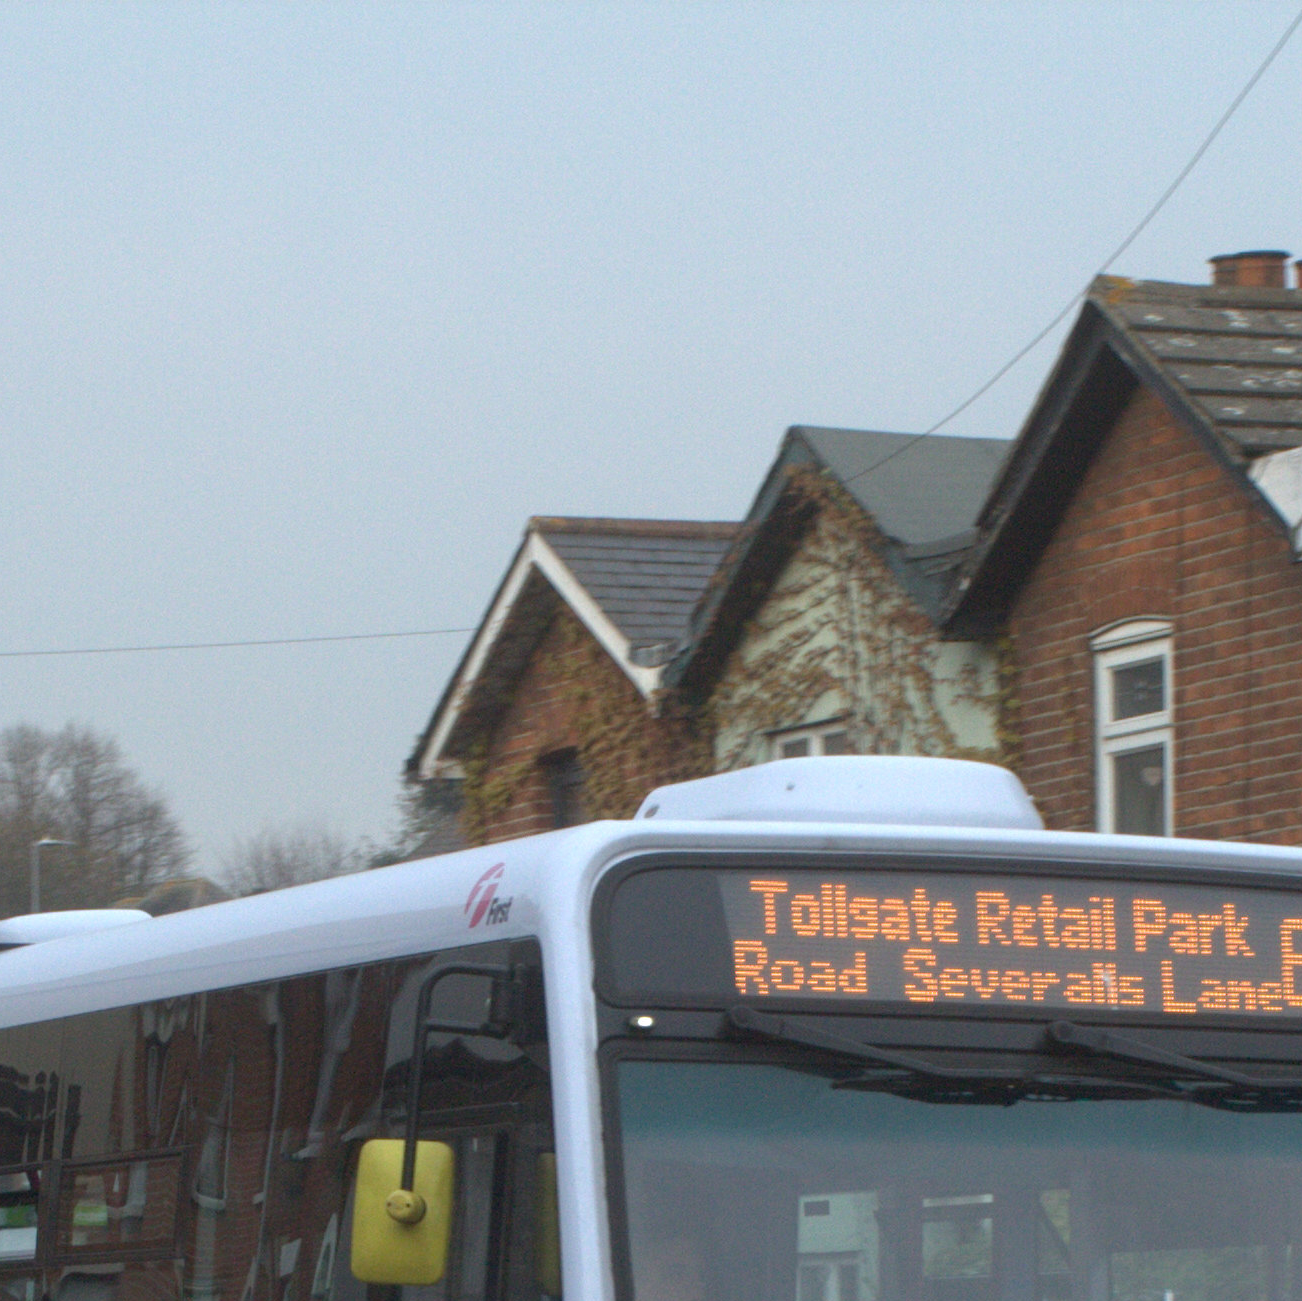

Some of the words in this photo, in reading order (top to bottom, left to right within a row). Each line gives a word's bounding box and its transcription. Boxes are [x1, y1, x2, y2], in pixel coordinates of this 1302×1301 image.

[749, 879, 959, 943] Tollgate
[975, 890, 1118, 951] Retail
[1132, 898, 1256, 957] Park
[734, 940, 869, 996] Road
[902, 948, 1145, 1005] Severalls
[1160, 960, 1285, 1013] Lane
